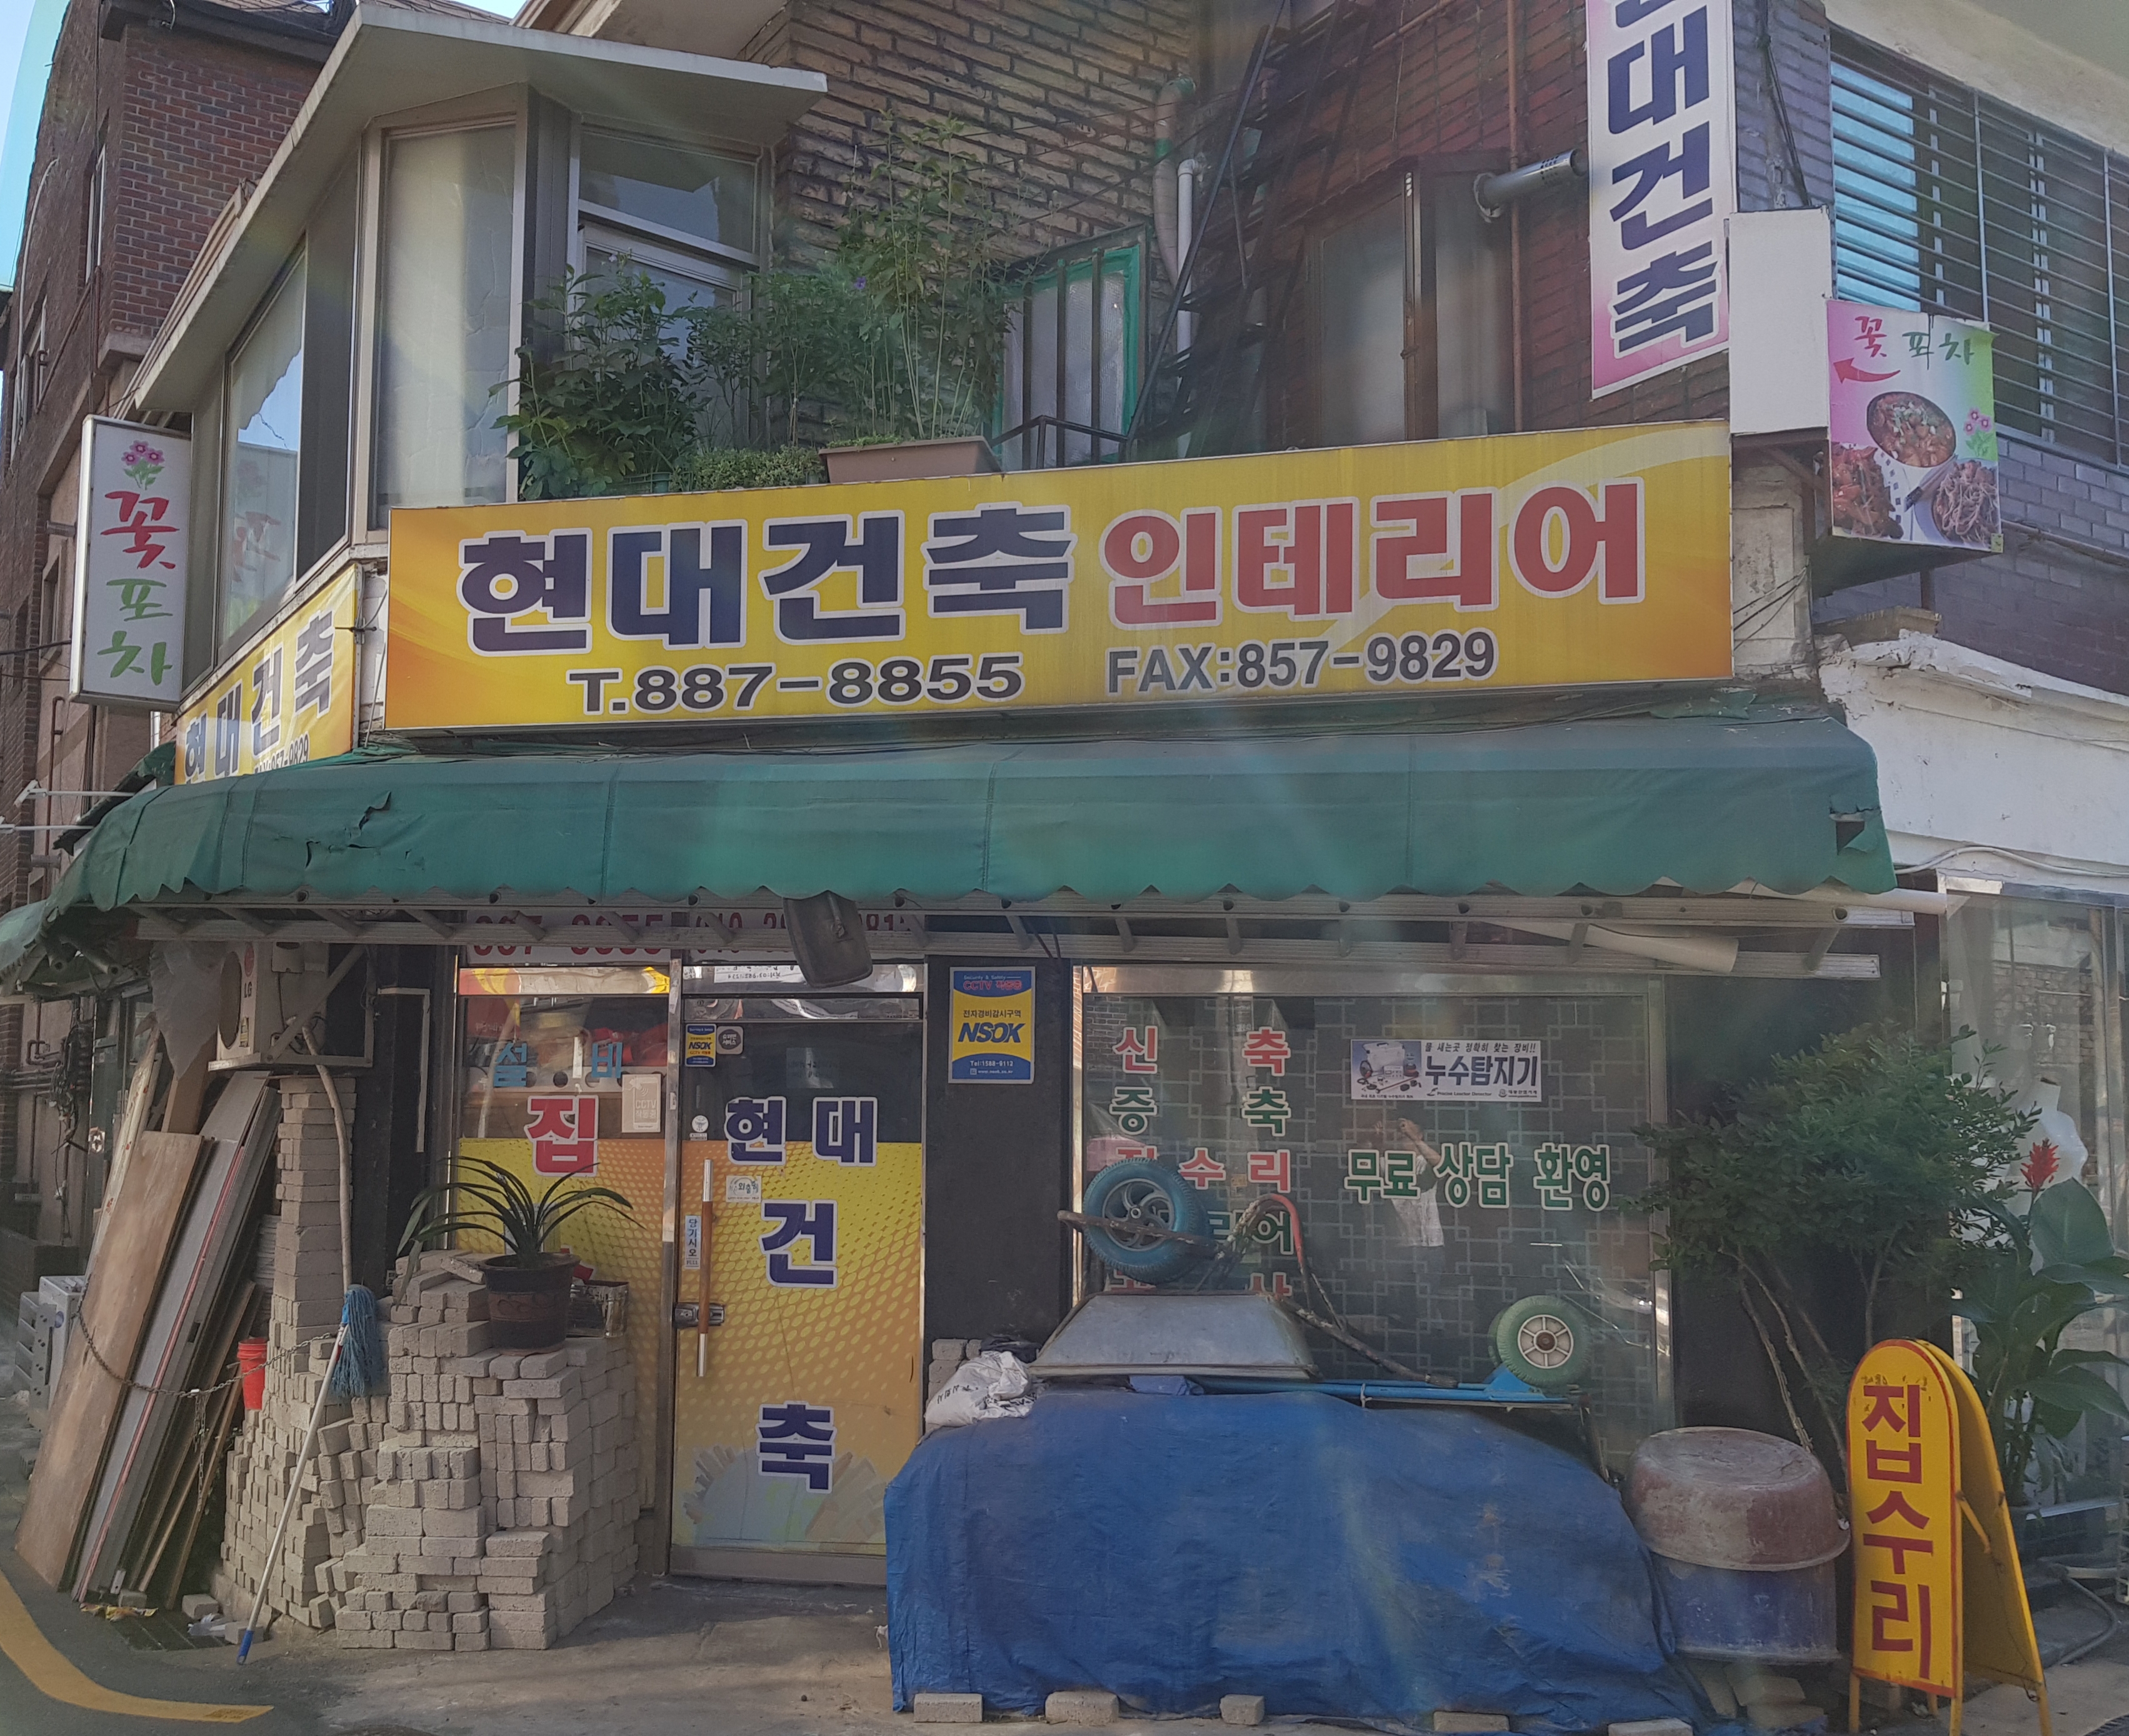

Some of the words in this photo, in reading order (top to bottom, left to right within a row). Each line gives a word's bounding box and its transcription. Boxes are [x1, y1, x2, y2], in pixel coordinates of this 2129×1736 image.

[1607, 0, 1719, 353] 대건축
[461, 506, 1074, 652] 현대건축
[1103, 482, 1639, 626] 인테리어
[568, 655, 1022, 712] T.887-8855
[1108, 631, 1495, 693] FAX:857-9829
[185, 609, 334, 781] 현대건축
[244, 981, 253, 998] LG
[963, 980, 993, 990] CCTV
[963, 1010, 1021, 1018] 전자경비감시구역
[688, 1041, 713, 1050] NSOK
[958, 1022, 1026, 1043] NSOK
[1465, 1042, 1489, 1053] 정확히
[1425, 1055, 1538, 1086] 누수탐지기
[635, 1100, 657, 1109] CCTV
[1346, 1151, 1418, 1202] 무료
[1438, 1145, 1511, 1205] 상담
[1536, 1145, 1608, 1209] 환영
[688, 1218, 698, 1257] 당기시오
[1861, 1383, 1933, 1680] 집수리
